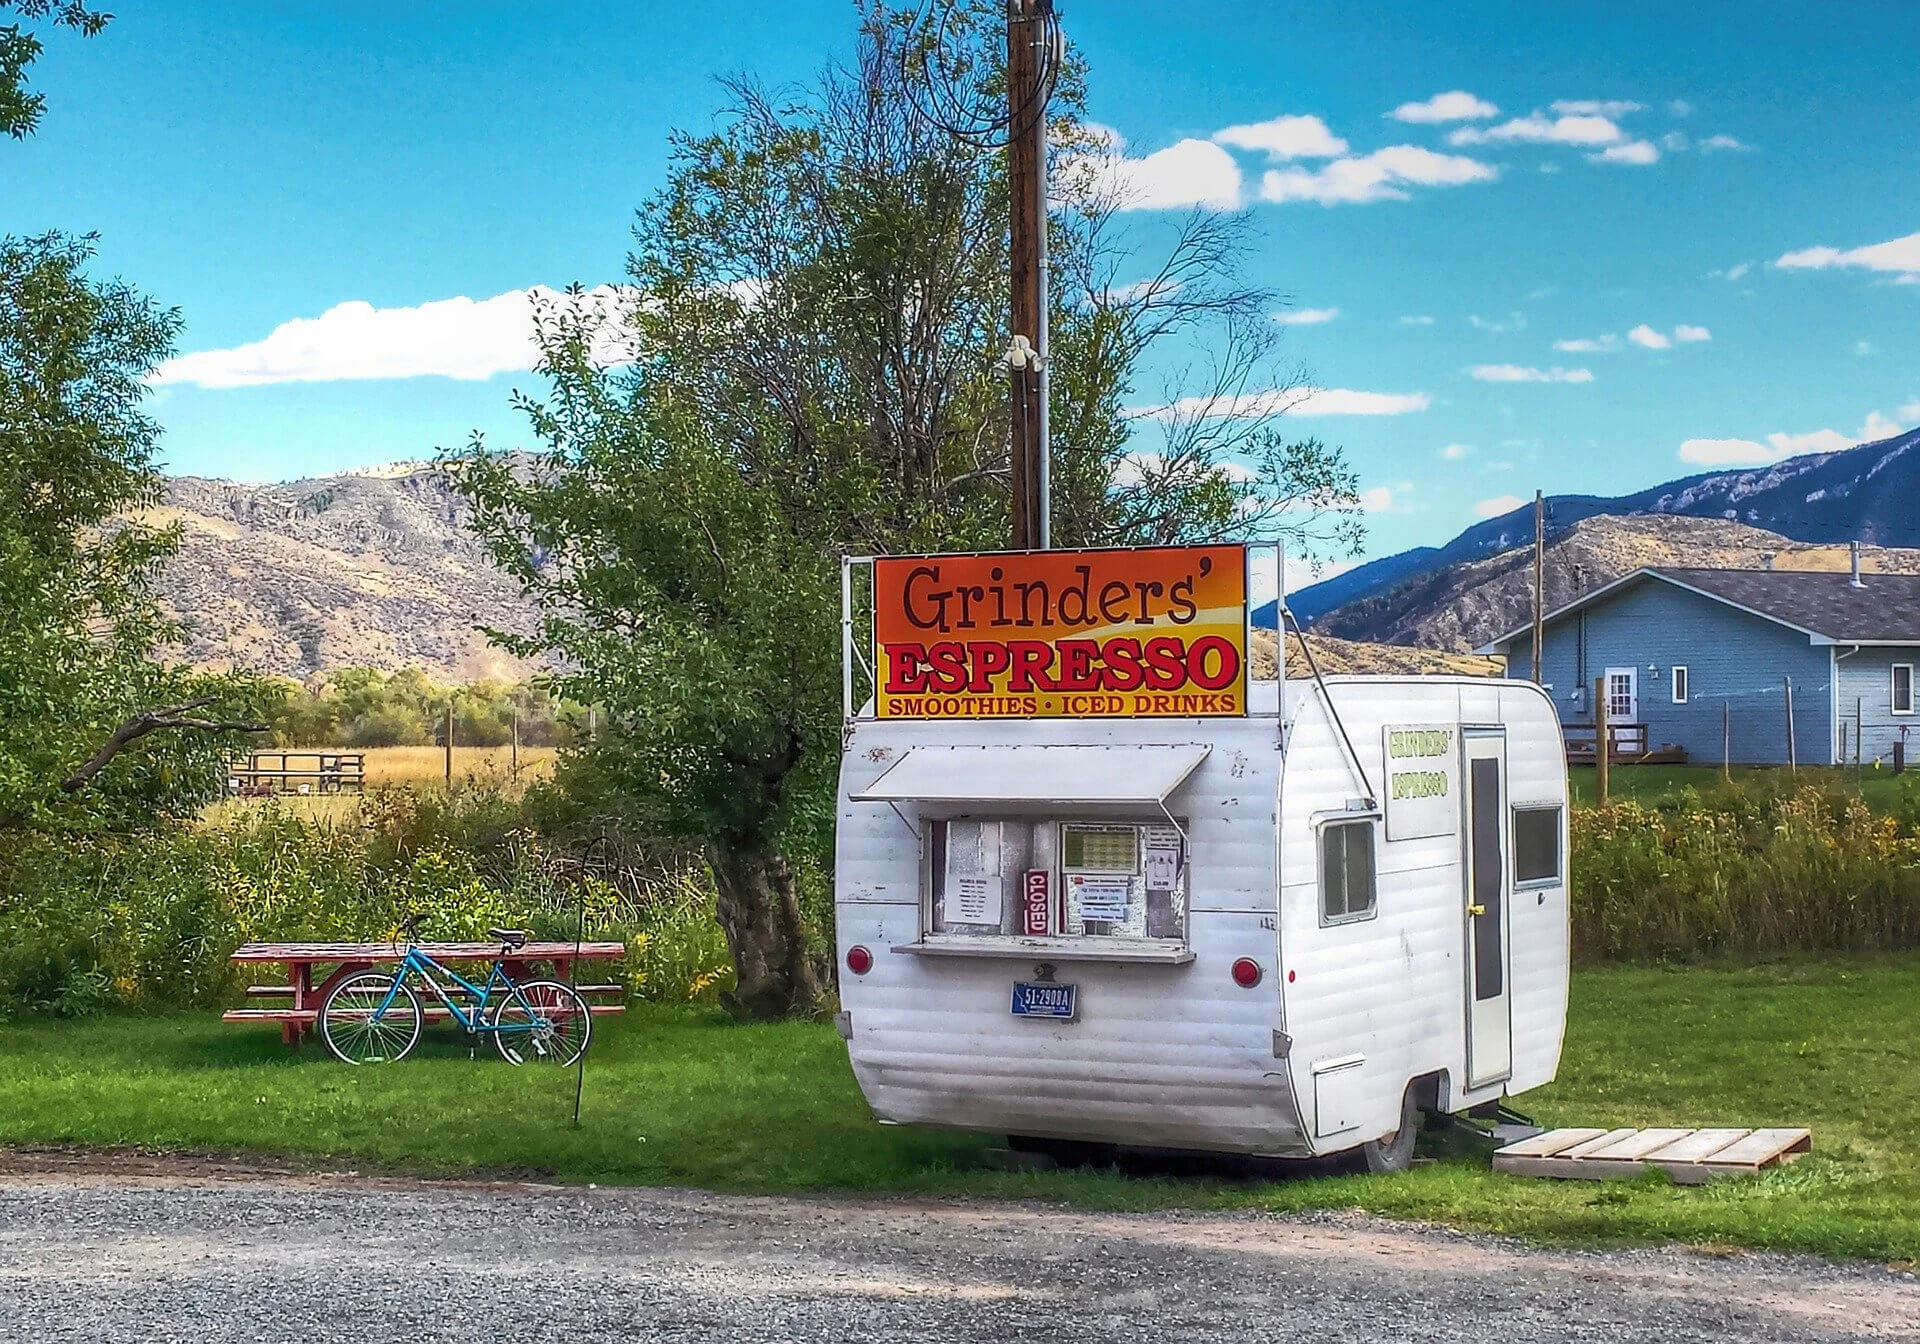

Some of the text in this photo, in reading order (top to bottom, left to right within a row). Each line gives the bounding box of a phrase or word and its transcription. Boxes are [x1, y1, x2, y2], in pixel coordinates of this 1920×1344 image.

[904, 556, 1211, 633] Grinders'
[884, 635, 1240, 694] ESPRESSO
[888, 694, 1236, 715] SMOOTHIES ICED DRINKS
[1030, 875, 1046, 930] CLOSED
